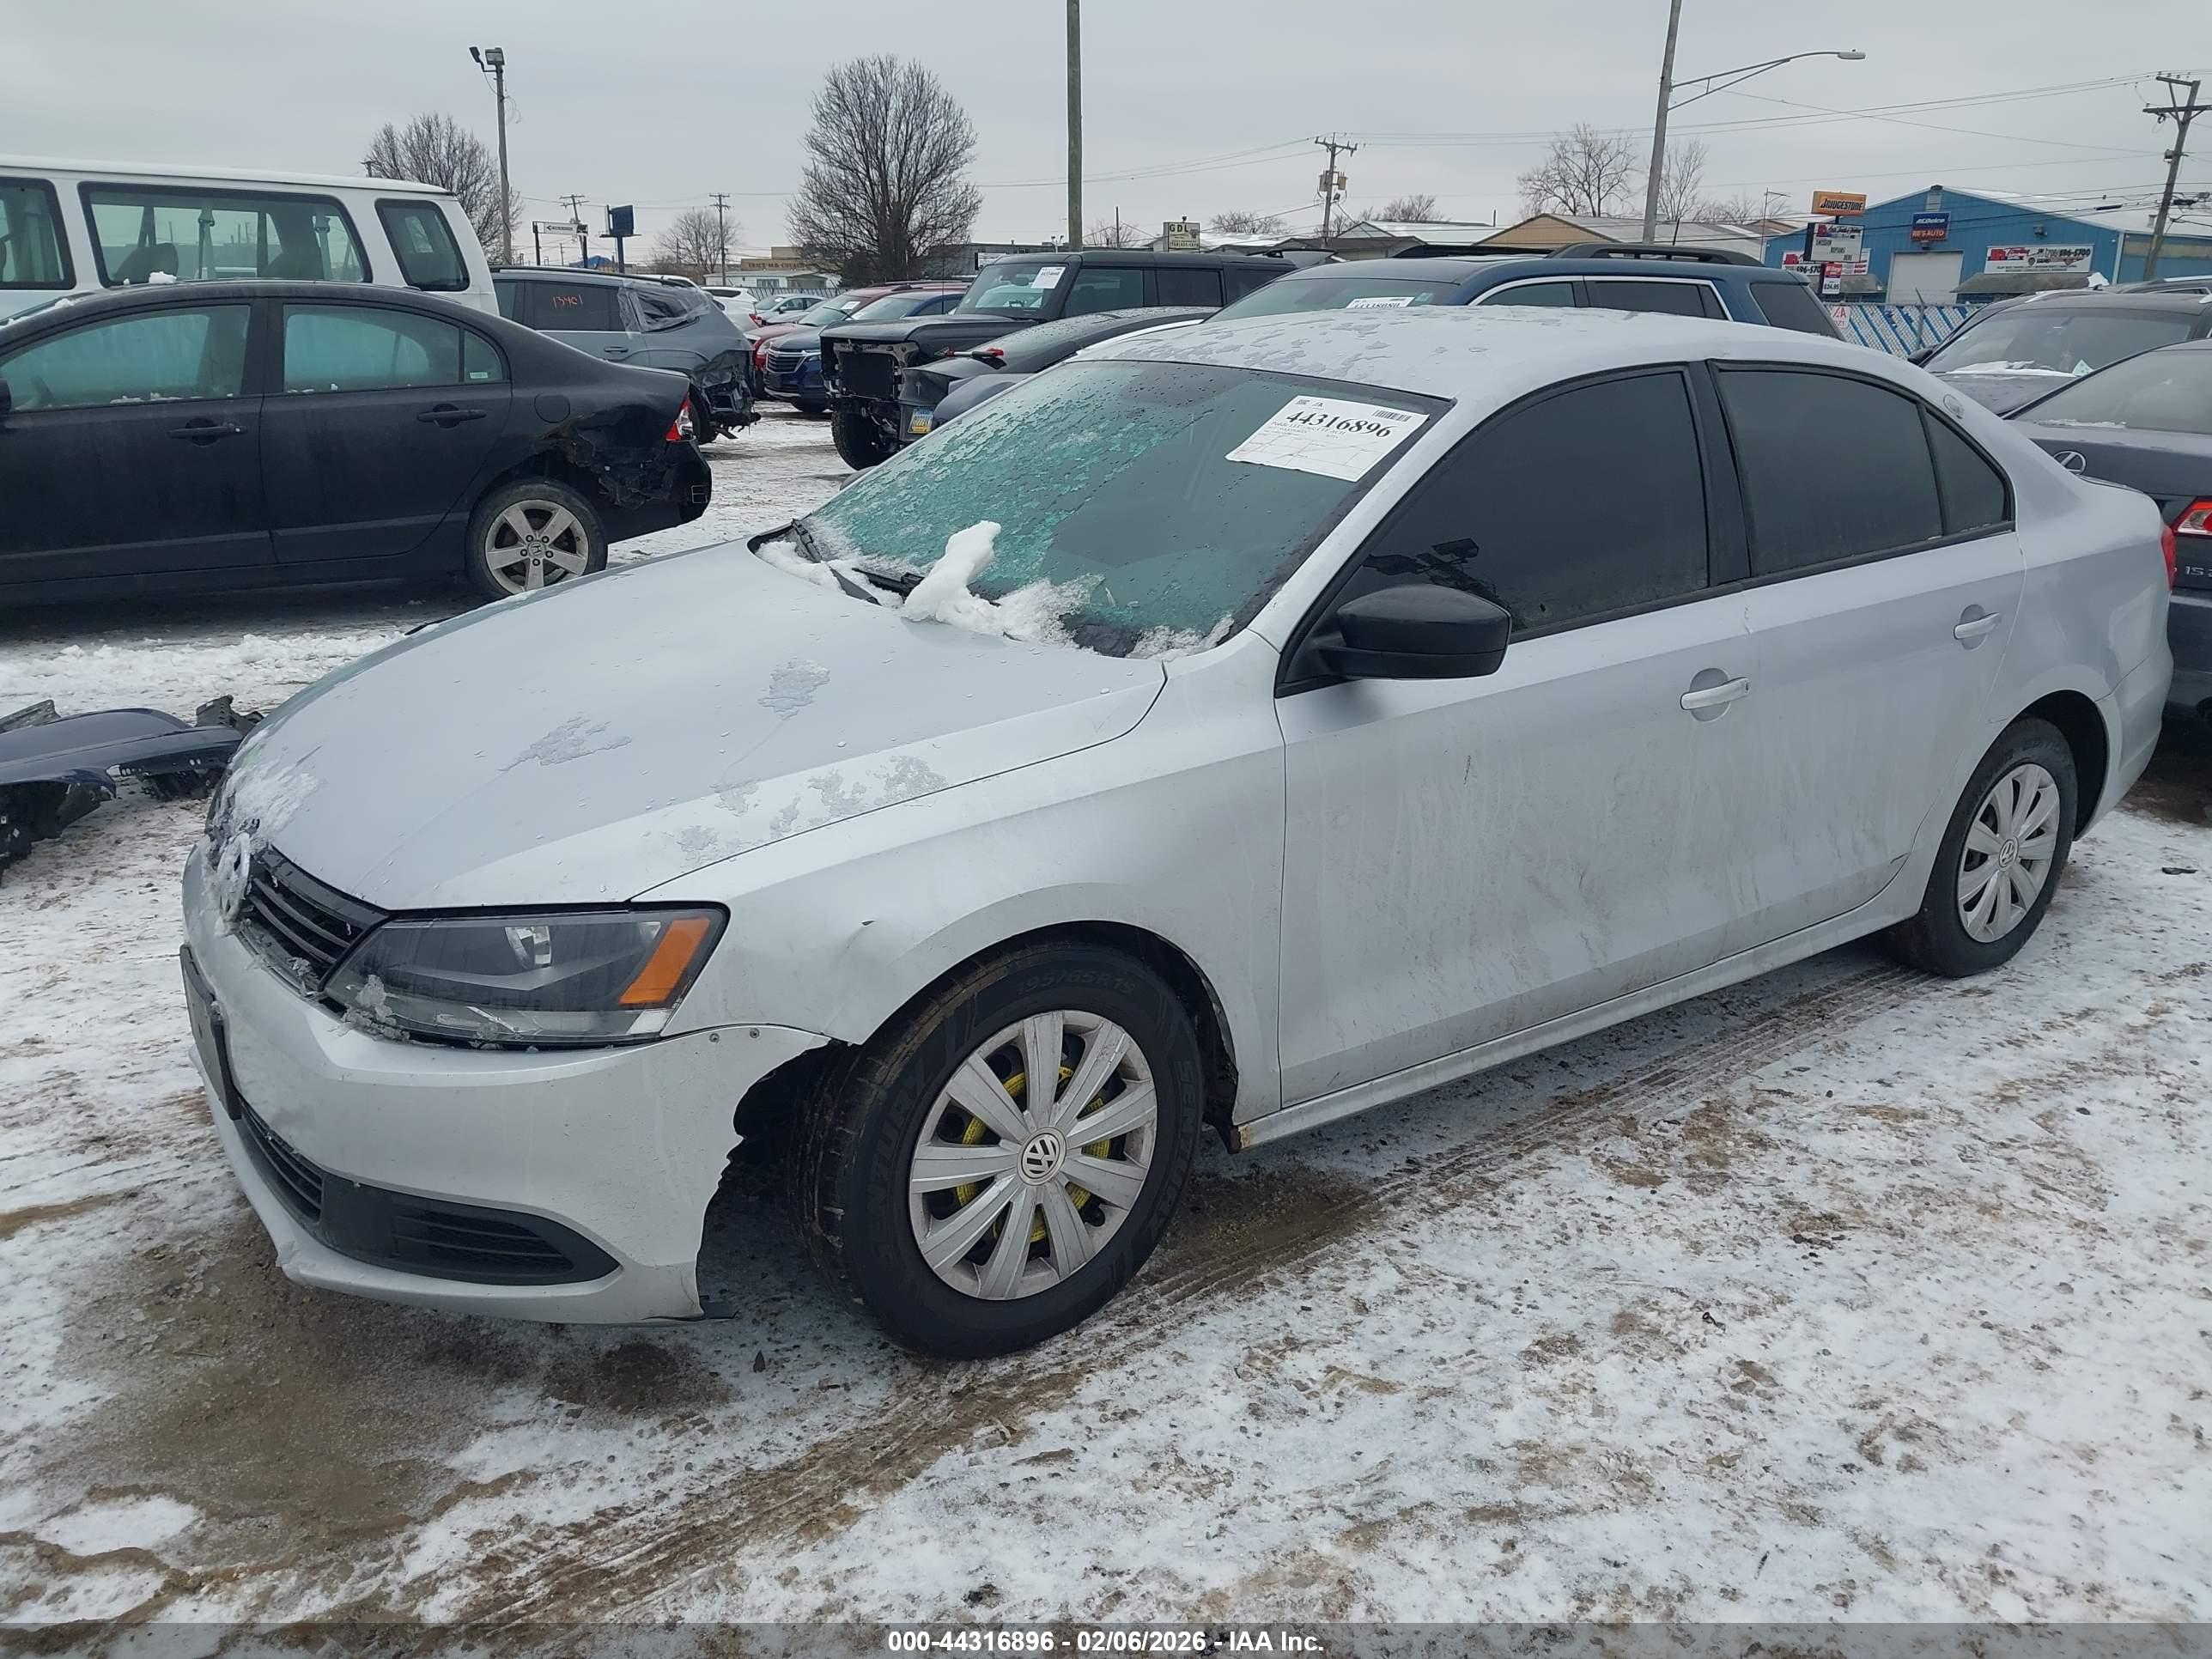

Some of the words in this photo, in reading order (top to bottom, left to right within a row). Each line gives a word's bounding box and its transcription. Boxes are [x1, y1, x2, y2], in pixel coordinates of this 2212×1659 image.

[1820, 198, 1863, 211] BRIDGESTONE
[1170, 224, 1189, 233] GDL
[1286, 410, 1397, 439] 44316896
